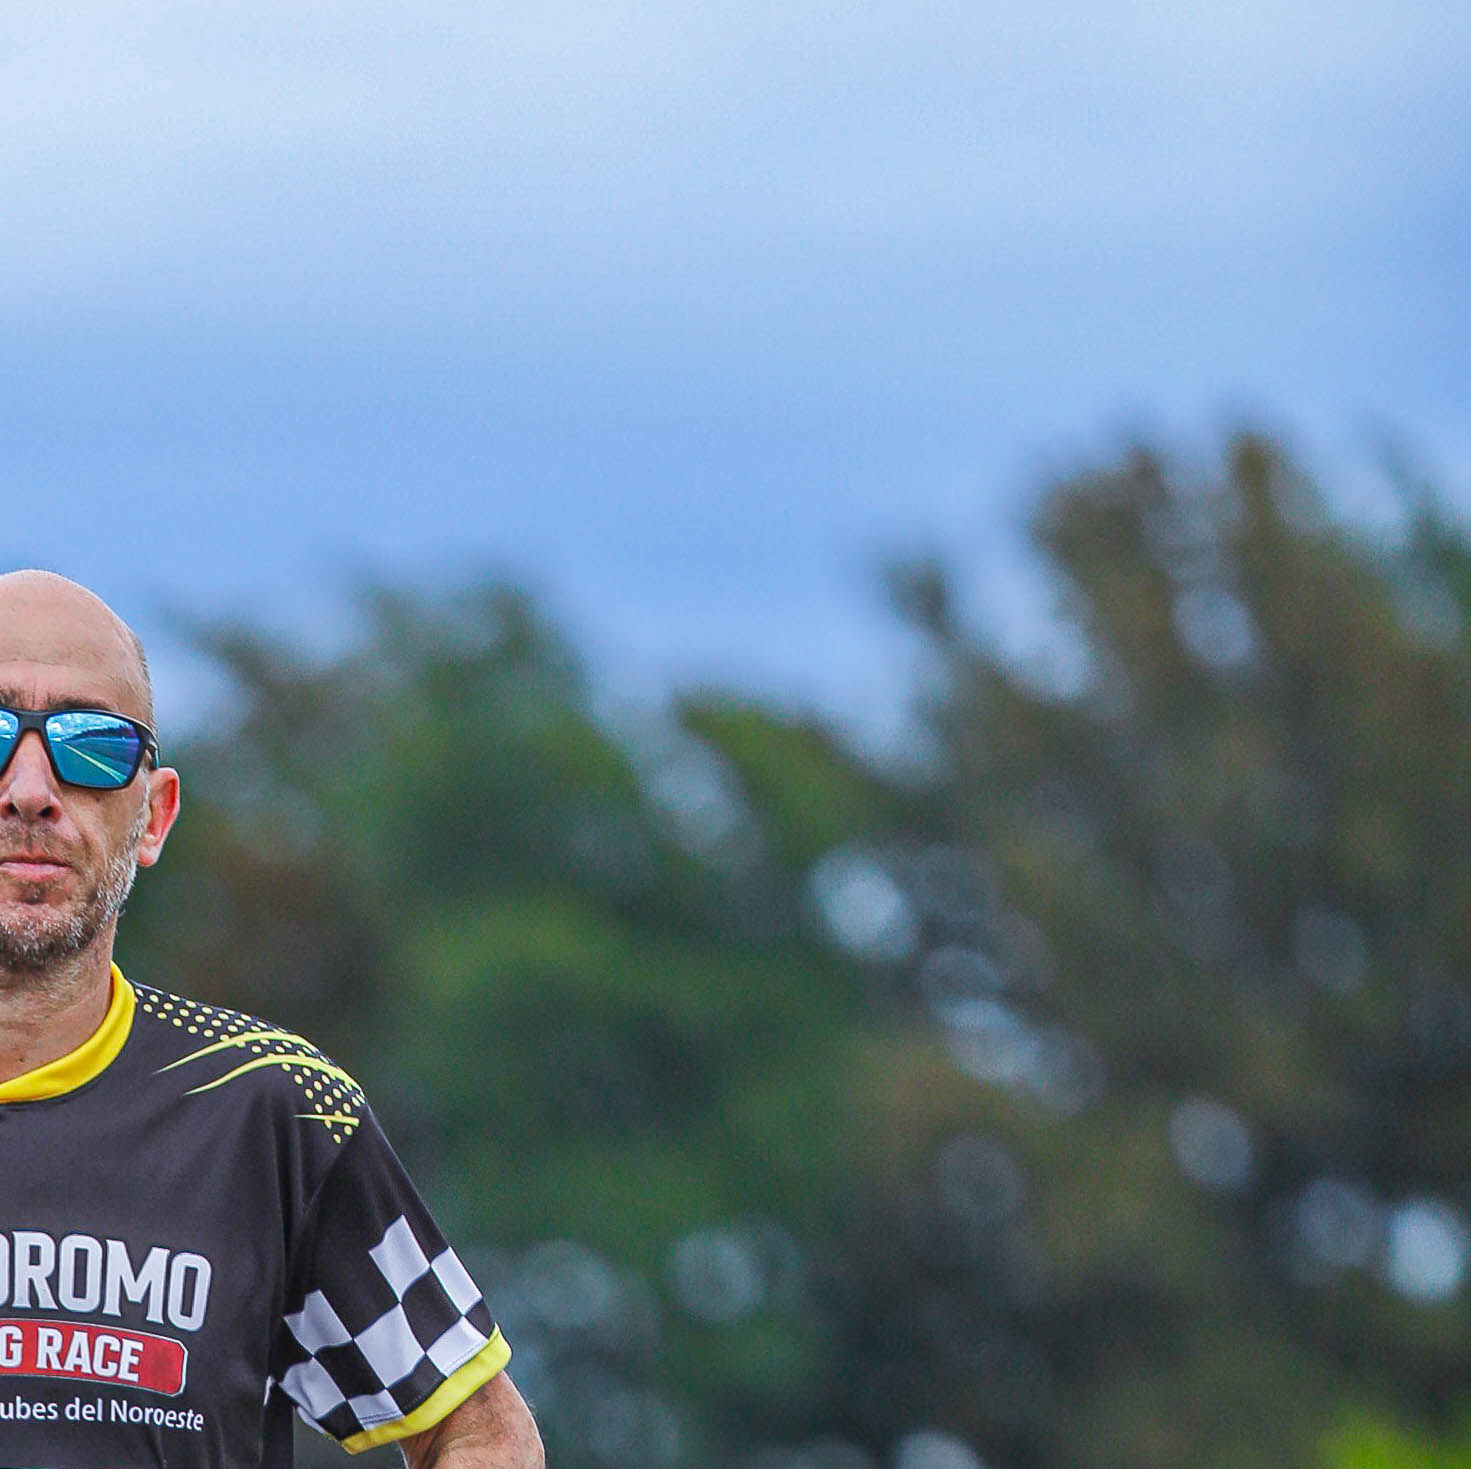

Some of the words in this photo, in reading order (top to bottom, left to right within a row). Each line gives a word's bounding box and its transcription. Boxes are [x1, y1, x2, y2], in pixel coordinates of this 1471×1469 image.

[35, 1327, 144, 1382] RACE
[65, 1398, 103, 1422] del
[110, 1404, 205, 1432] Noroeste
